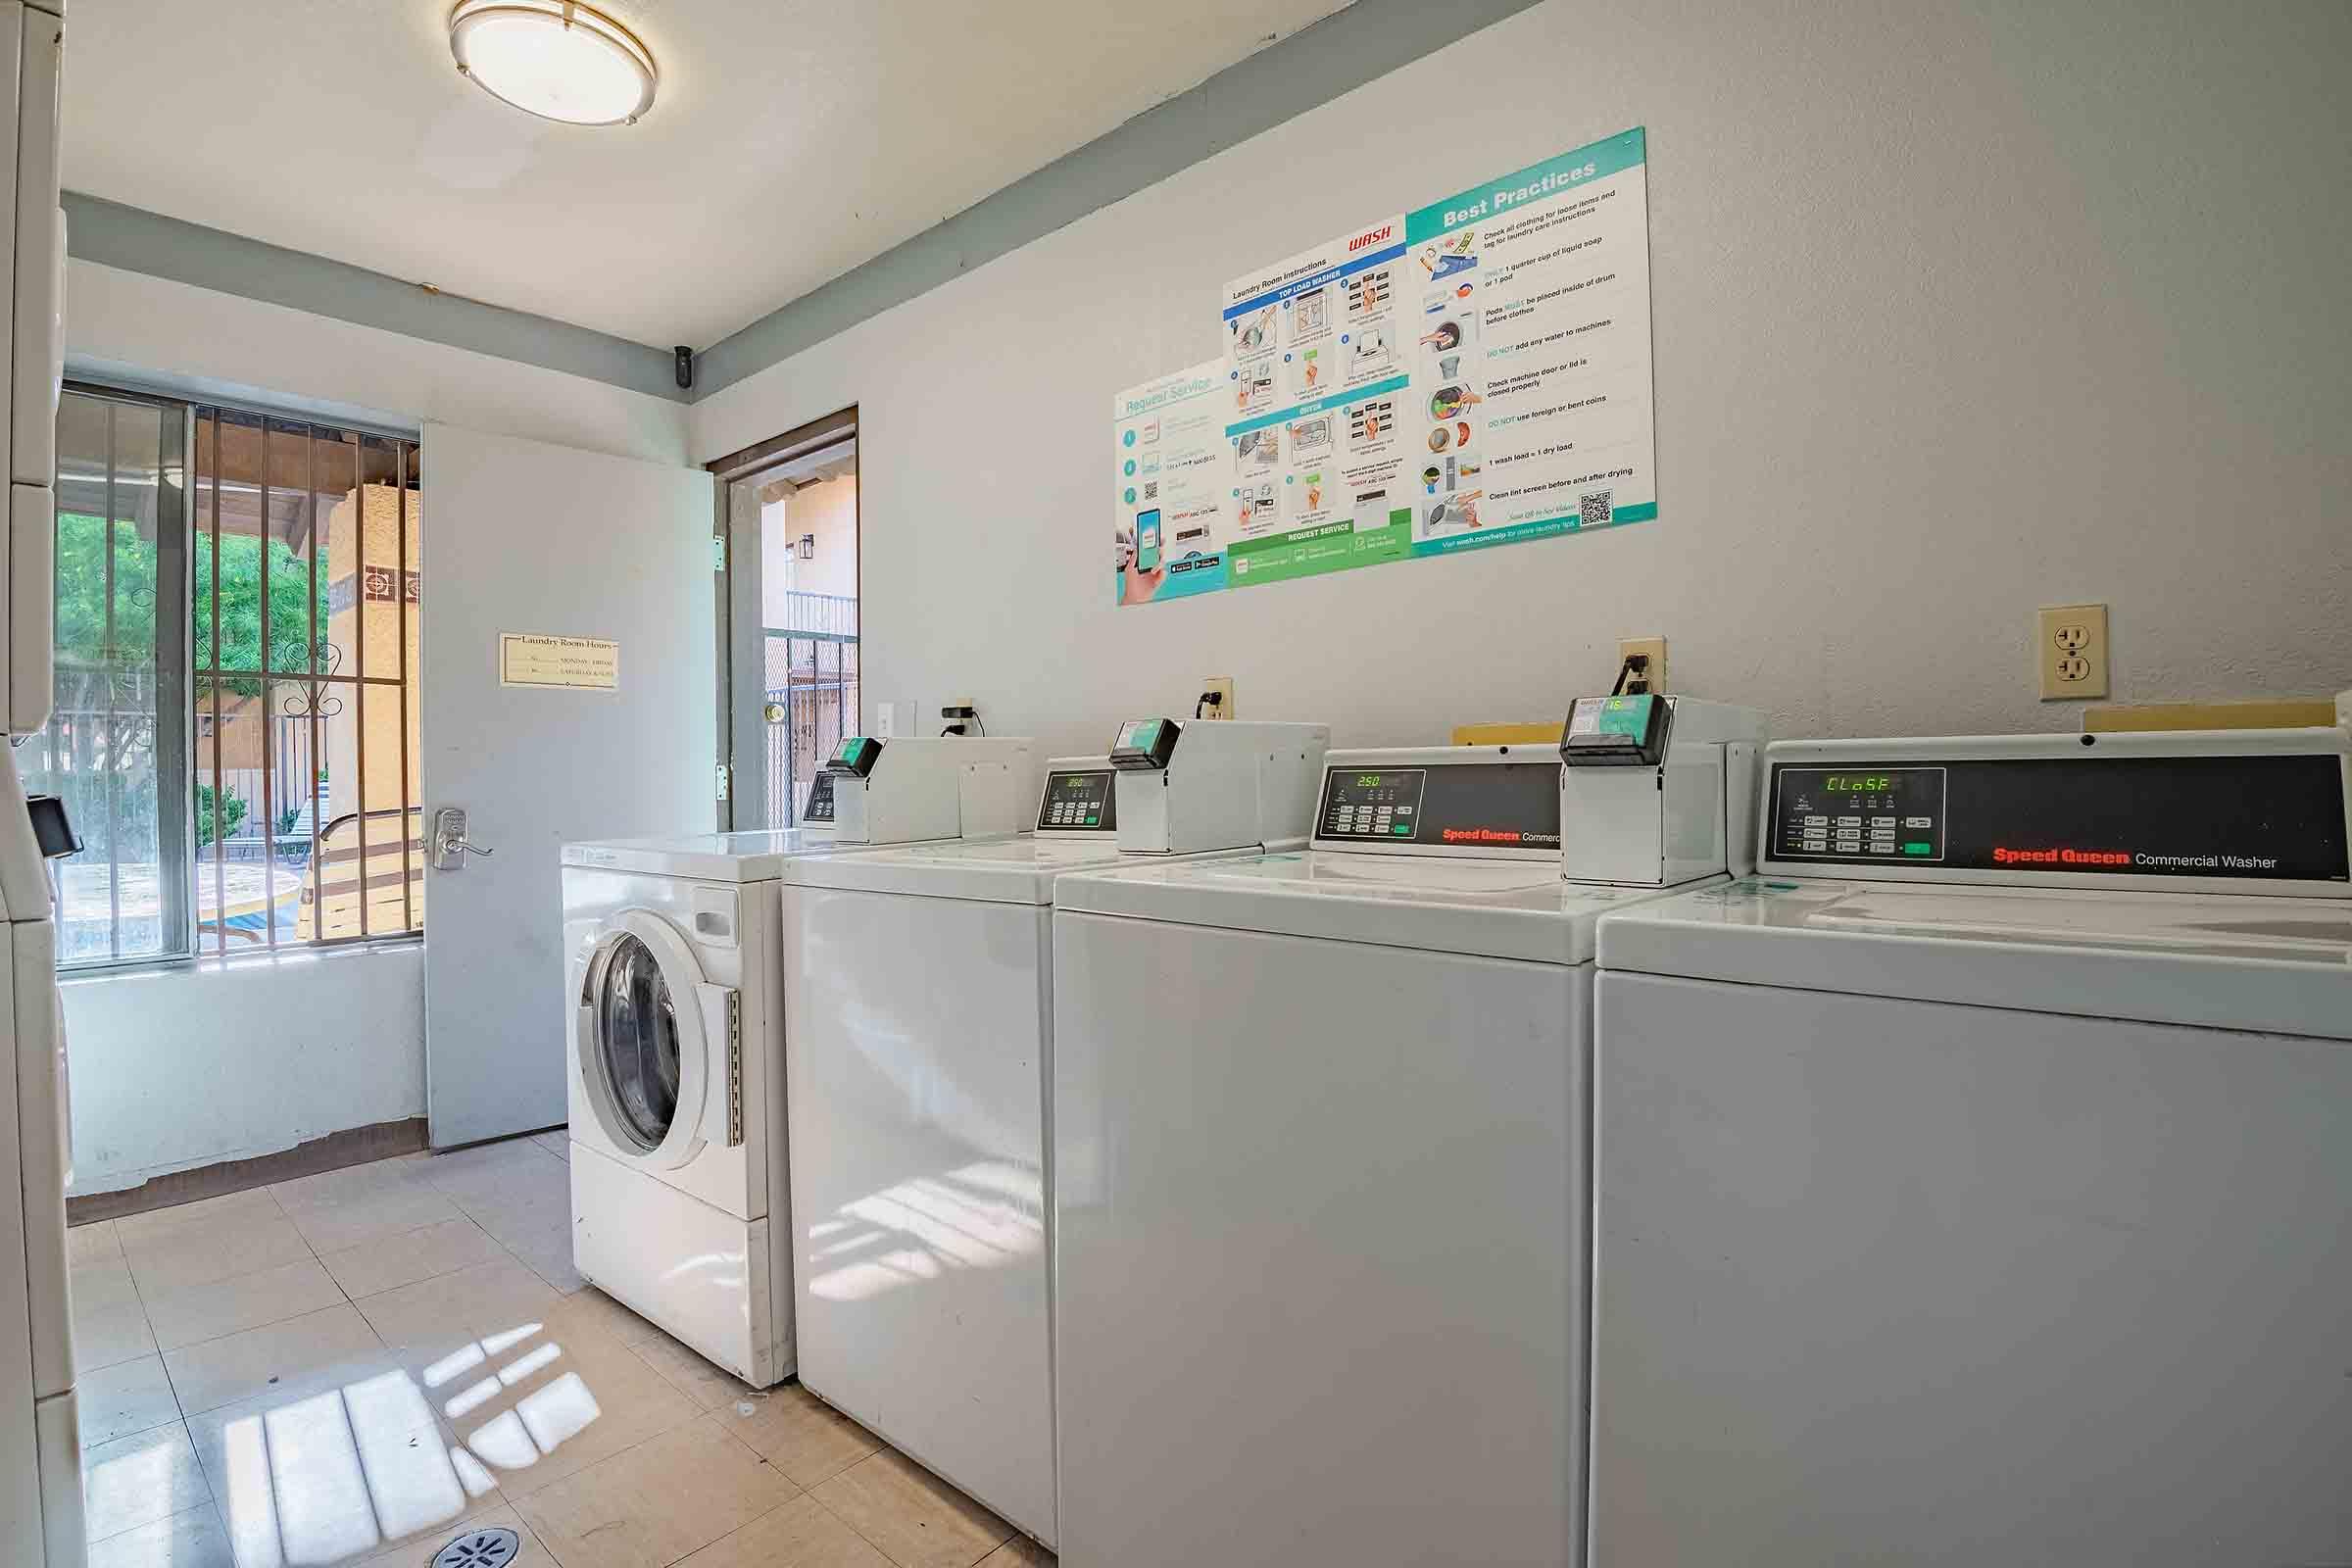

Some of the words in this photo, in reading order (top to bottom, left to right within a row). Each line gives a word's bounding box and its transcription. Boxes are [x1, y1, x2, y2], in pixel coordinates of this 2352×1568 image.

[1443, 198, 1488, 227] Best
[1494, 161, 1596, 209] Practices
[1484, 228, 1505, 240] Check
[1516, 214, 1544, 230] clothing
[1545, 211, 1556, 220] for
[1557, 204, 1578, 216] loose
[1579, 197, 1599, 209] items
[1601, 189, 1616, 201] and
[1484, 239, 1494, 249] tag
[1507, 227, 1534, 242] laundry
[1535, 221, 1550, 232] care
[1551, 207, 1595, 227] instructions
[1348, 225, 1392, 252] WASH
[1511, 257, 1537, 271] quarter
[1538, 253, 1551, 263] cup
[1552, 248, 1560, 257] of
[1561, 243, 1583, 255] liquid
[1584, 236, 1602, 248] soap
[1232, 282, 1260, 300] Laundry
[1261, 274, 1283, 289] Room
[1284, 258, 1327, 280] Instructions
[1279, 288, 1293, 299] TOP
[1293, 282, 1311, 294] LOAD
[1312, 270, 1342, 287] WASHER
[1499, 273, 1513, 284] pod
[1485, 307, 1503, 317] Pods
[1537, 290, 1561, 303] placed
[1562, 282, 1585, 295] inside
[1586, 278, 1594, 287] of
[1595, 272, 1616, 284] drum
[1486, 315, 1508, 325] before
[1509, 307, 1535, 318] clothes
[1487, 350, 1497, 359] DO
[1498, 344, 1515, 355] NOT
[1515, 342, 1529, 351] add
[1530, 337, 1544, 347] any
[1544, 332, 1565, 343] water
[1575, 318, 1612, 334] machines
[1487, 379, 1509, 389] Check
[1510, 371, 1540, 384] machine
[1541, 366, 1558, 375] door
[1569, 360, 1579, 368] lid
[1487, 387, 1510, 398] closed
[1511, 379, 1542, 394] properly
[1488, 419, 1498, 429] DO
[1499, 416, 1516, 425] NOT
[1517, 413, 1530, 422] use
[1531, 407, 1557, 419] foreign
[1568, 399, 1585, 410] bent
[1586, 394, 1607, 406] coins
[1494, 455, 1513, 466] wash
[1514, 452, 1530, 461] load
[1543, 445, 1555, 456] dry
[1556, 442, 1573, 452] load
[1489, 490, 1509, 501] Clean
[1510, 487, 1522, 496] lint
[1523, 484, 1547, 494] screen
[1548, 478, 1572, 490] before
[1573, 475, 1588, 485] and
[1589, 471, 1606, 482] after
[1607, 466, 1634, 479] drying
[1288, 529, 1318, 542] REQUEST
[1320, 522, 1349, 535] SERVICE
[1456, 532, 1506, 546] wash.com/help
[521, 635, 559, 648] Laundry
[561, 638, 585, 648] Room
[587, 640, 612, 650] Hours
[1443, 828, 1479, 841] Speed
[1481, 829, 1520, 841] Queen
[1992, 847, 2058, 863] Speed
[2061, 849, 2130, 864] Queen
[2134, 853, 2218, 867] Commercial
[2222, 855, 2278, 868] Washer
